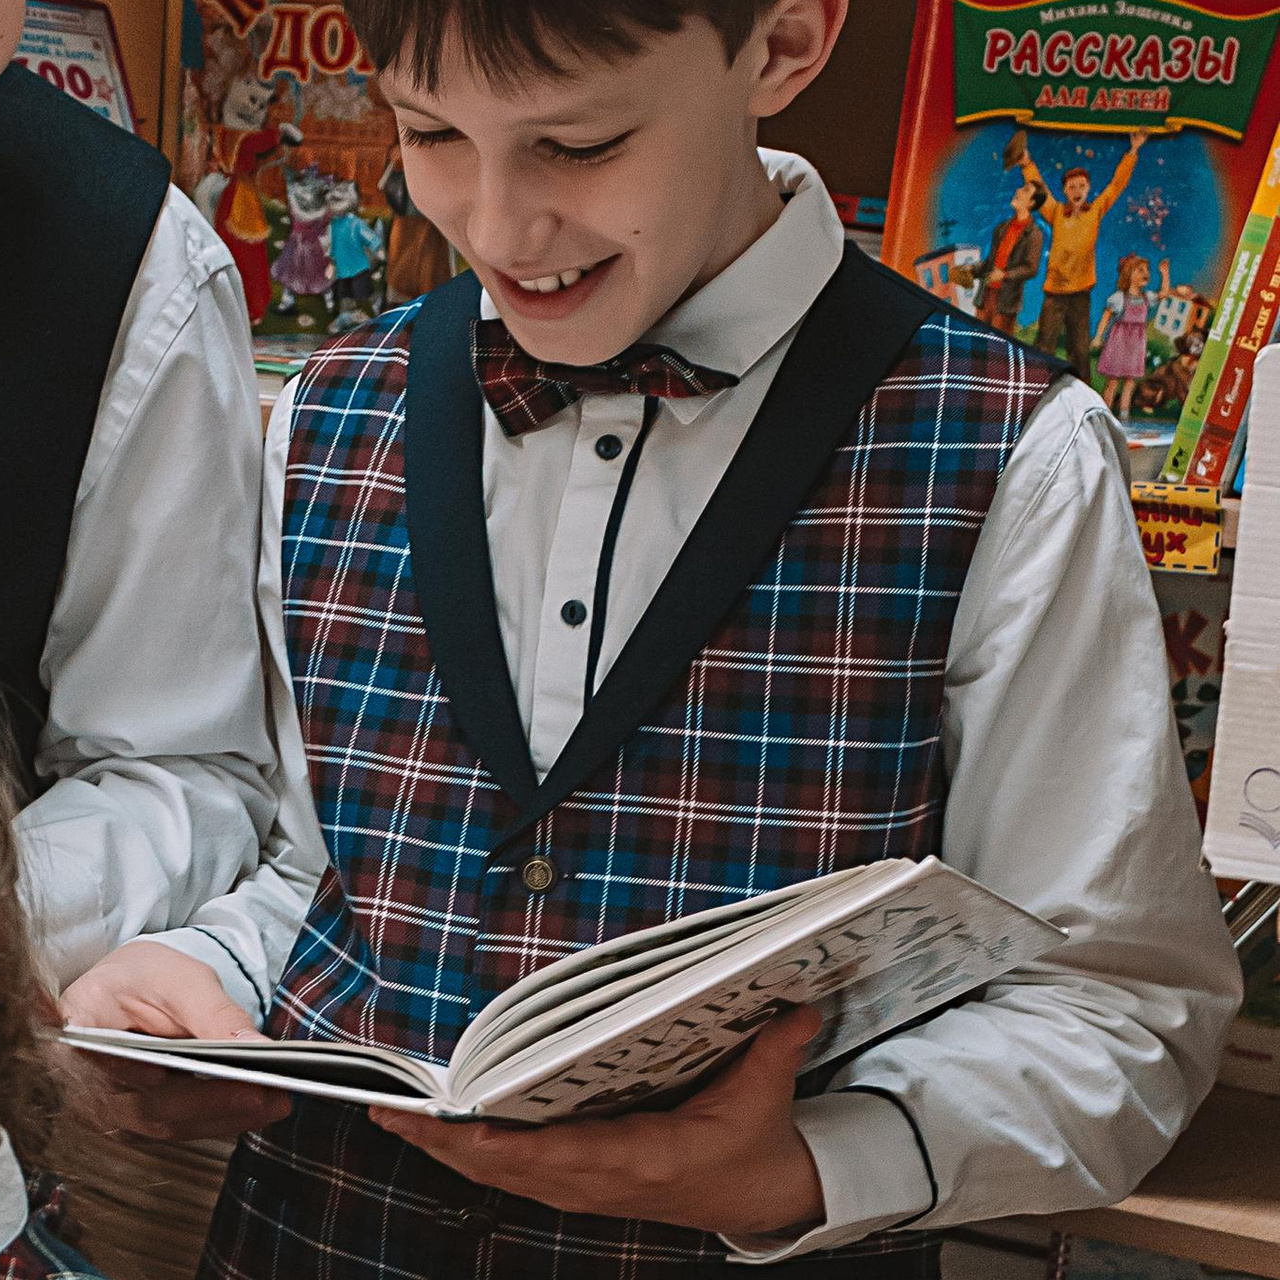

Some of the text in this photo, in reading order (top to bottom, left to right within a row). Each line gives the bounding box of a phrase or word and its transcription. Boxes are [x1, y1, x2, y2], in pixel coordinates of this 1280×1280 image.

[260, 3, 376, 82] ДО
[983, 28, 1241, 85] РАССКАЗЫ
[1034, 85, 1172, 112] ДЛЯ ДЕТЕЙ
[526, 904, 934, 1105] ПРИРОДА
